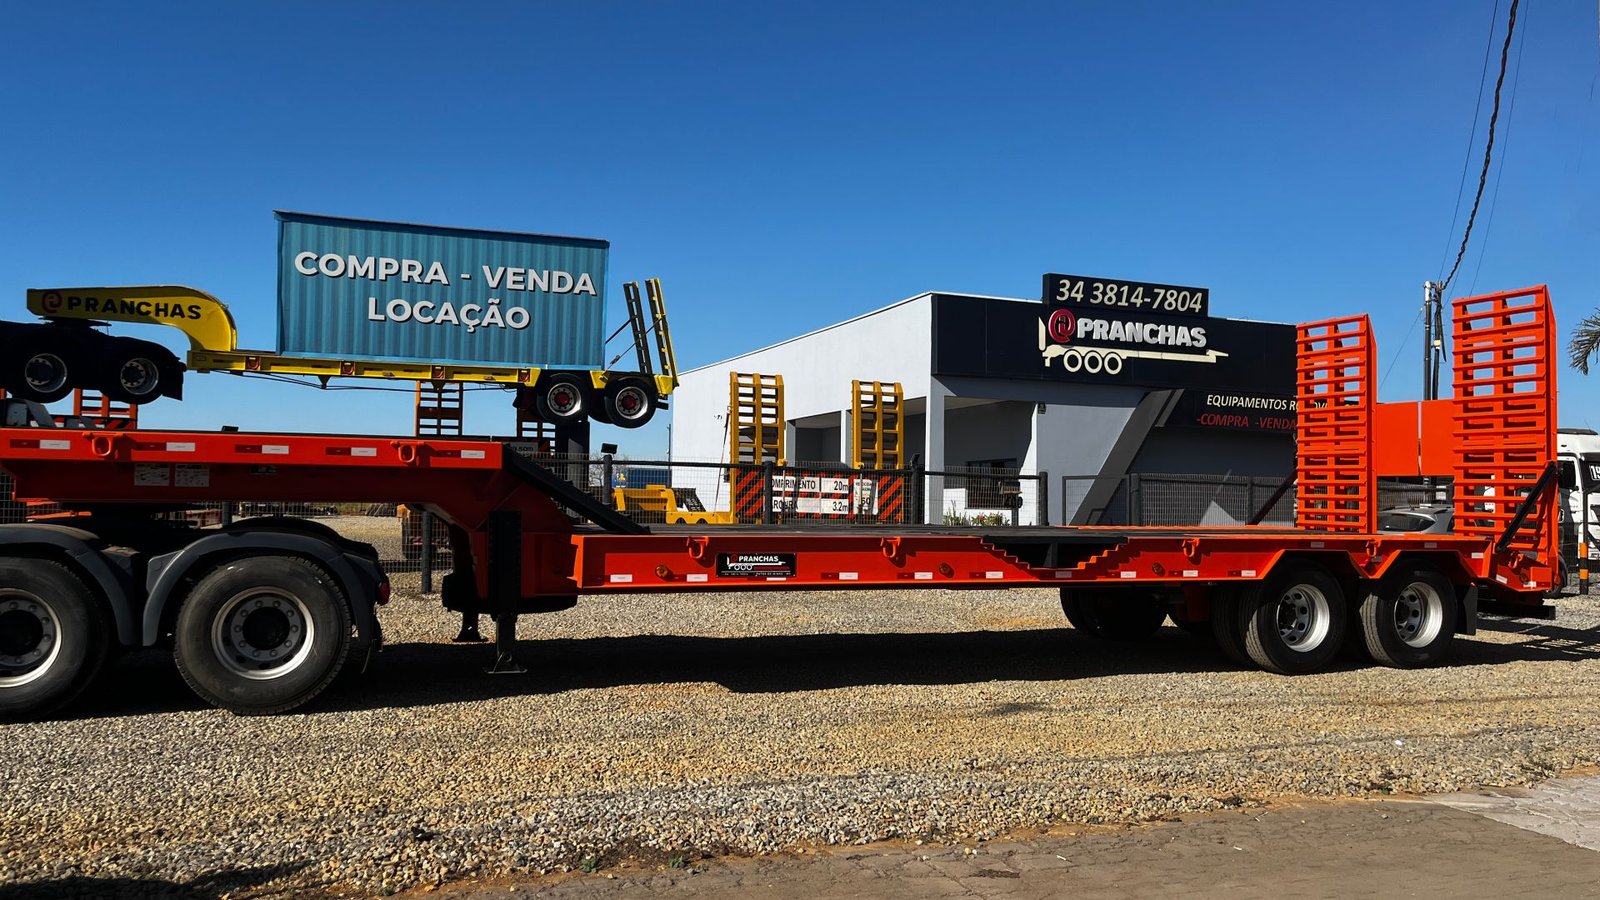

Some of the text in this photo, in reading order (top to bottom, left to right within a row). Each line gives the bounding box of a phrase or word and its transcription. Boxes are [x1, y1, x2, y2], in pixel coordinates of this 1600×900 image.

[294, 251, 450, 285] COMPRA
[482, 264, 598, 296] VENDA
[67, 295, 202, 320] PRANCHAS
[1056, 278, 1203, 313] 34 3814-7804
[367, 297, 532, 333] LOCAÇÃO
[1077, 317, 1208, 348] PRANCHAS
[1206, 394, 1287, 411] EQUIPAMENTOS
[770, 478, 816, 491] OMPRIMENTO
[738, 555, 779, 563] PRANCHAS
